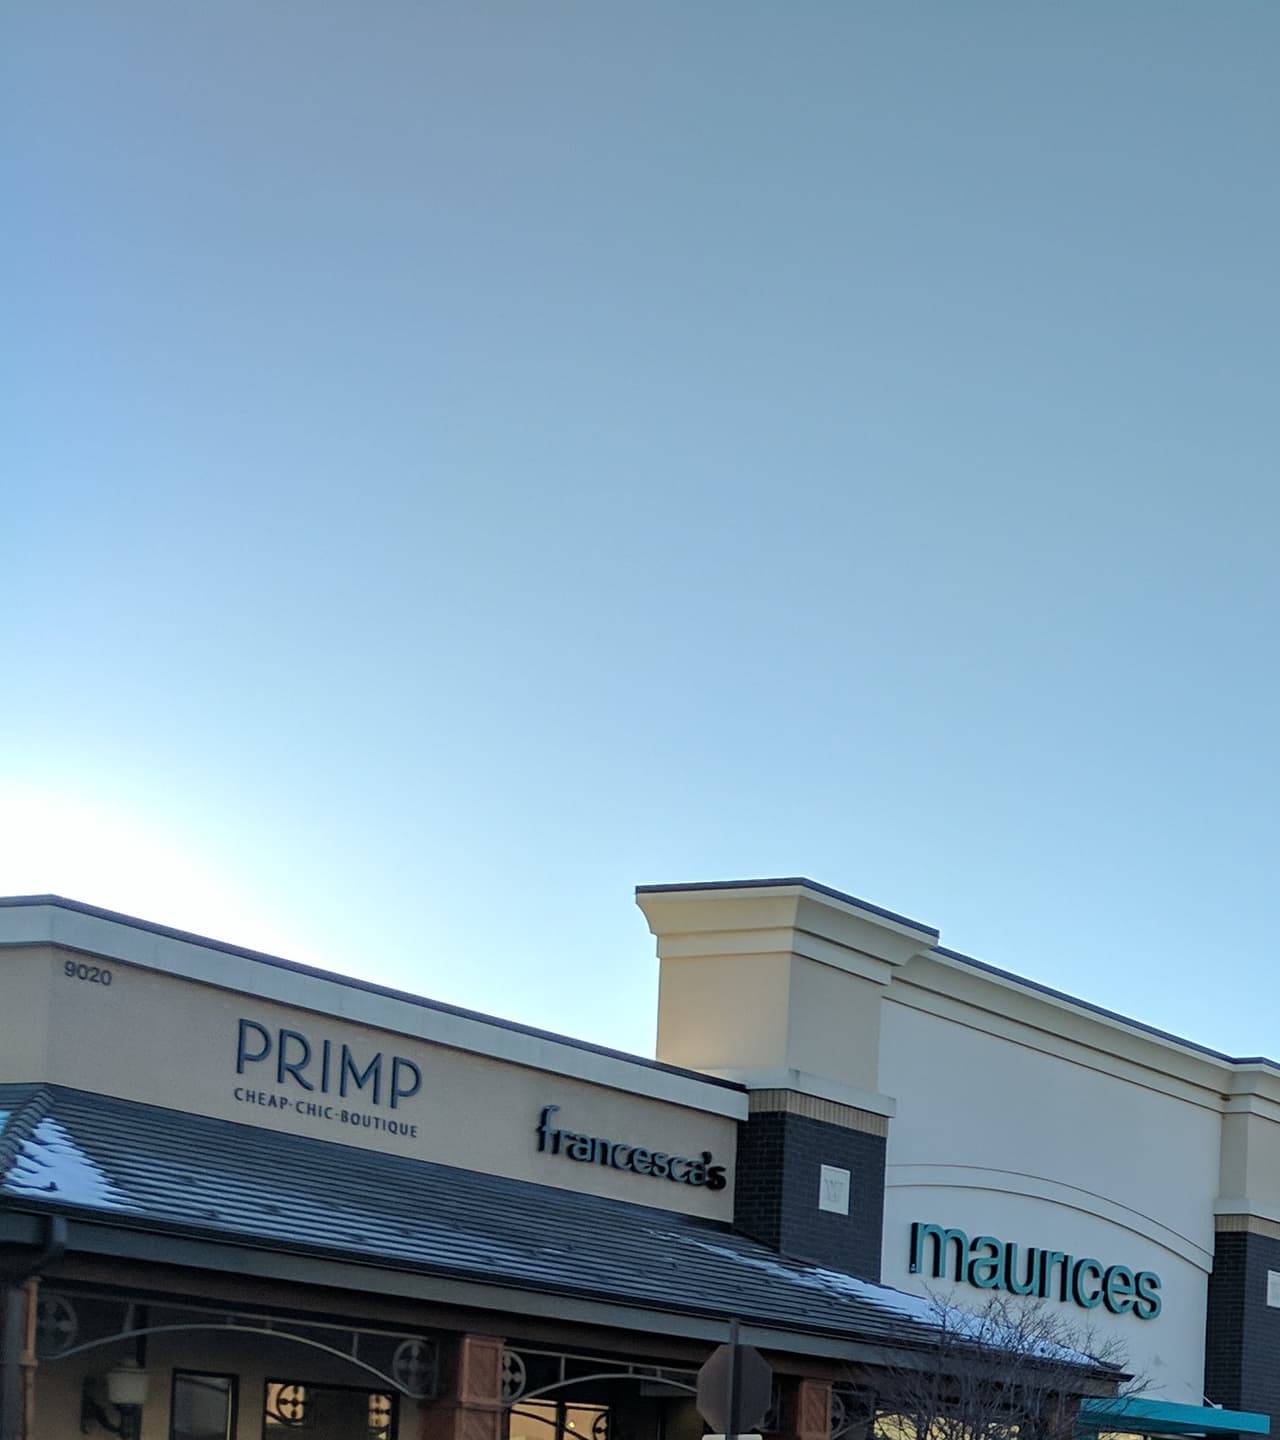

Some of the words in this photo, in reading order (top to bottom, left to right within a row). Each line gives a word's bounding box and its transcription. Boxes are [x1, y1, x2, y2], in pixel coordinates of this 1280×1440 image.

[64, 960, 113, 987] 9020
[236, 1018, 423, 1109] PRIMP
[537, 1104, 727, 1191] francesca's
[909, 1222, 1162, 1320] maurices
